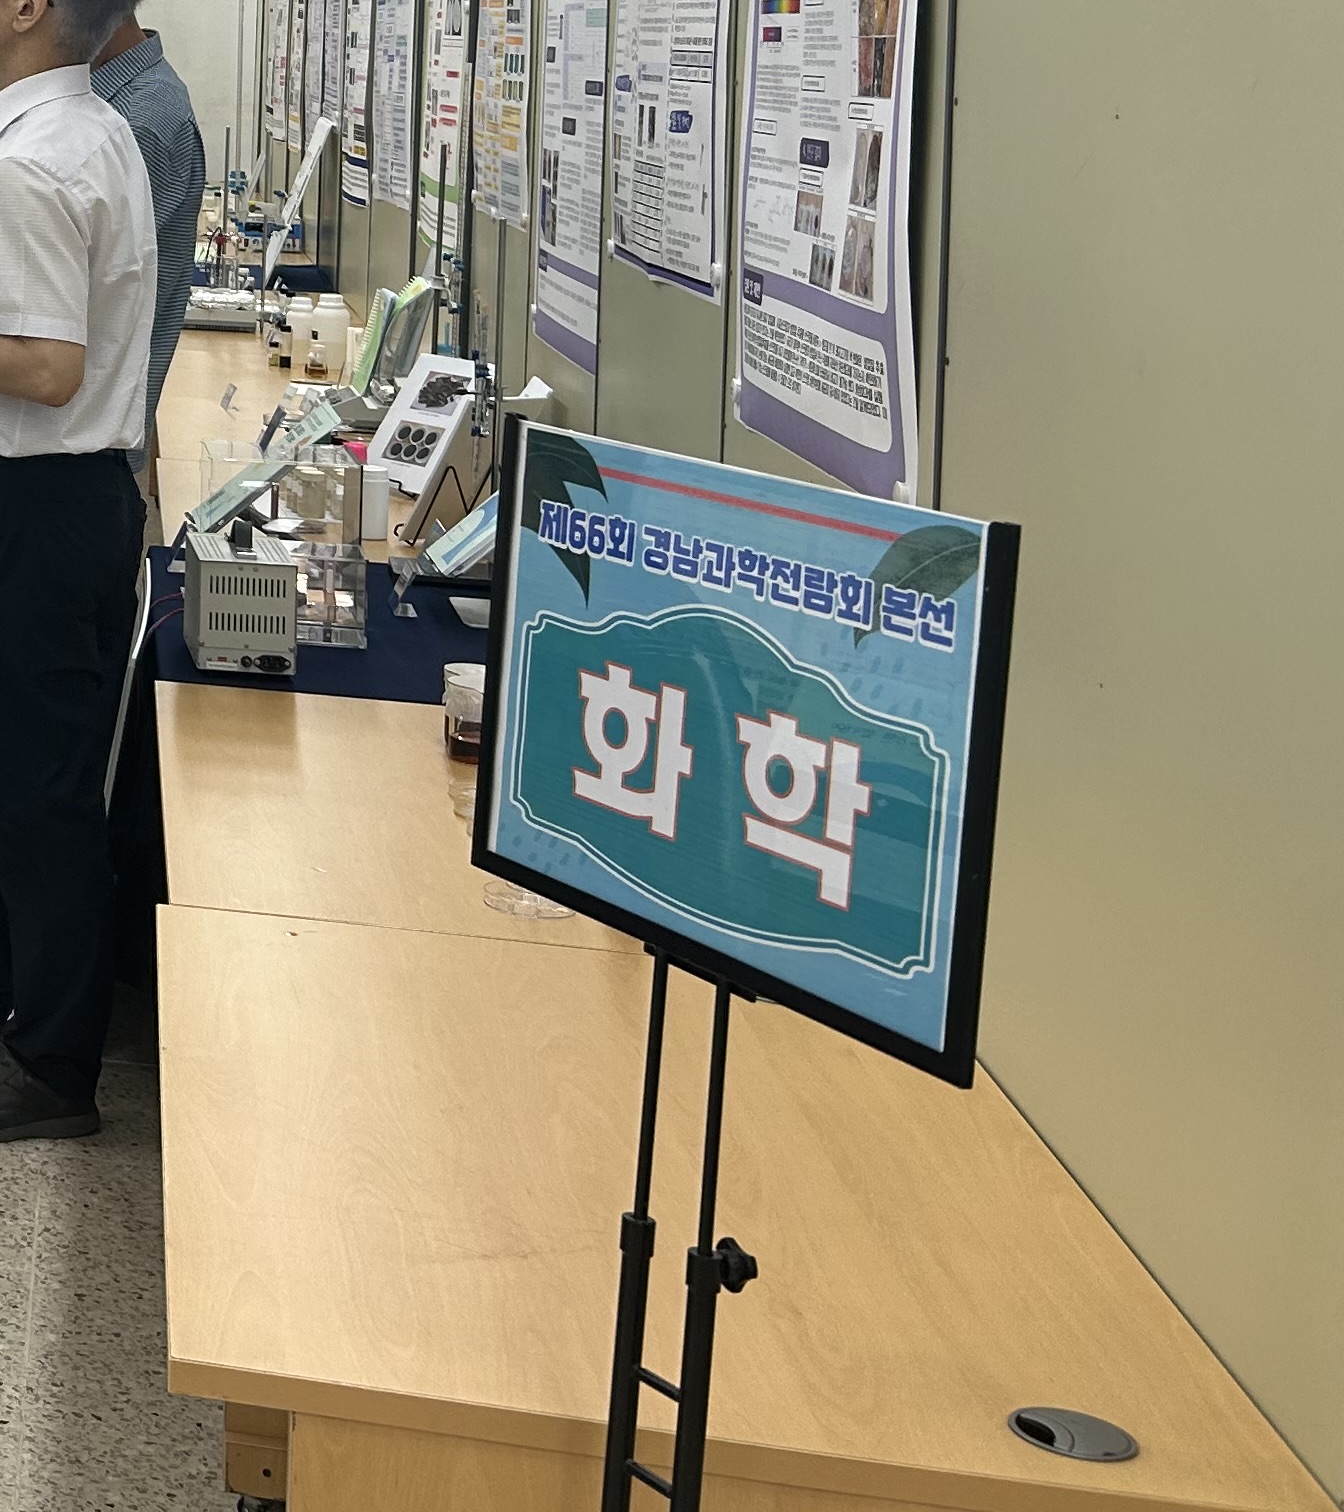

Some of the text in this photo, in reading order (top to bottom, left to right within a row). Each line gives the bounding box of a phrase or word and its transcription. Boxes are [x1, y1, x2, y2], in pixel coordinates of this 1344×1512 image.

[537, 498, 959, 653] 제66회 경남과학전람회 본선
